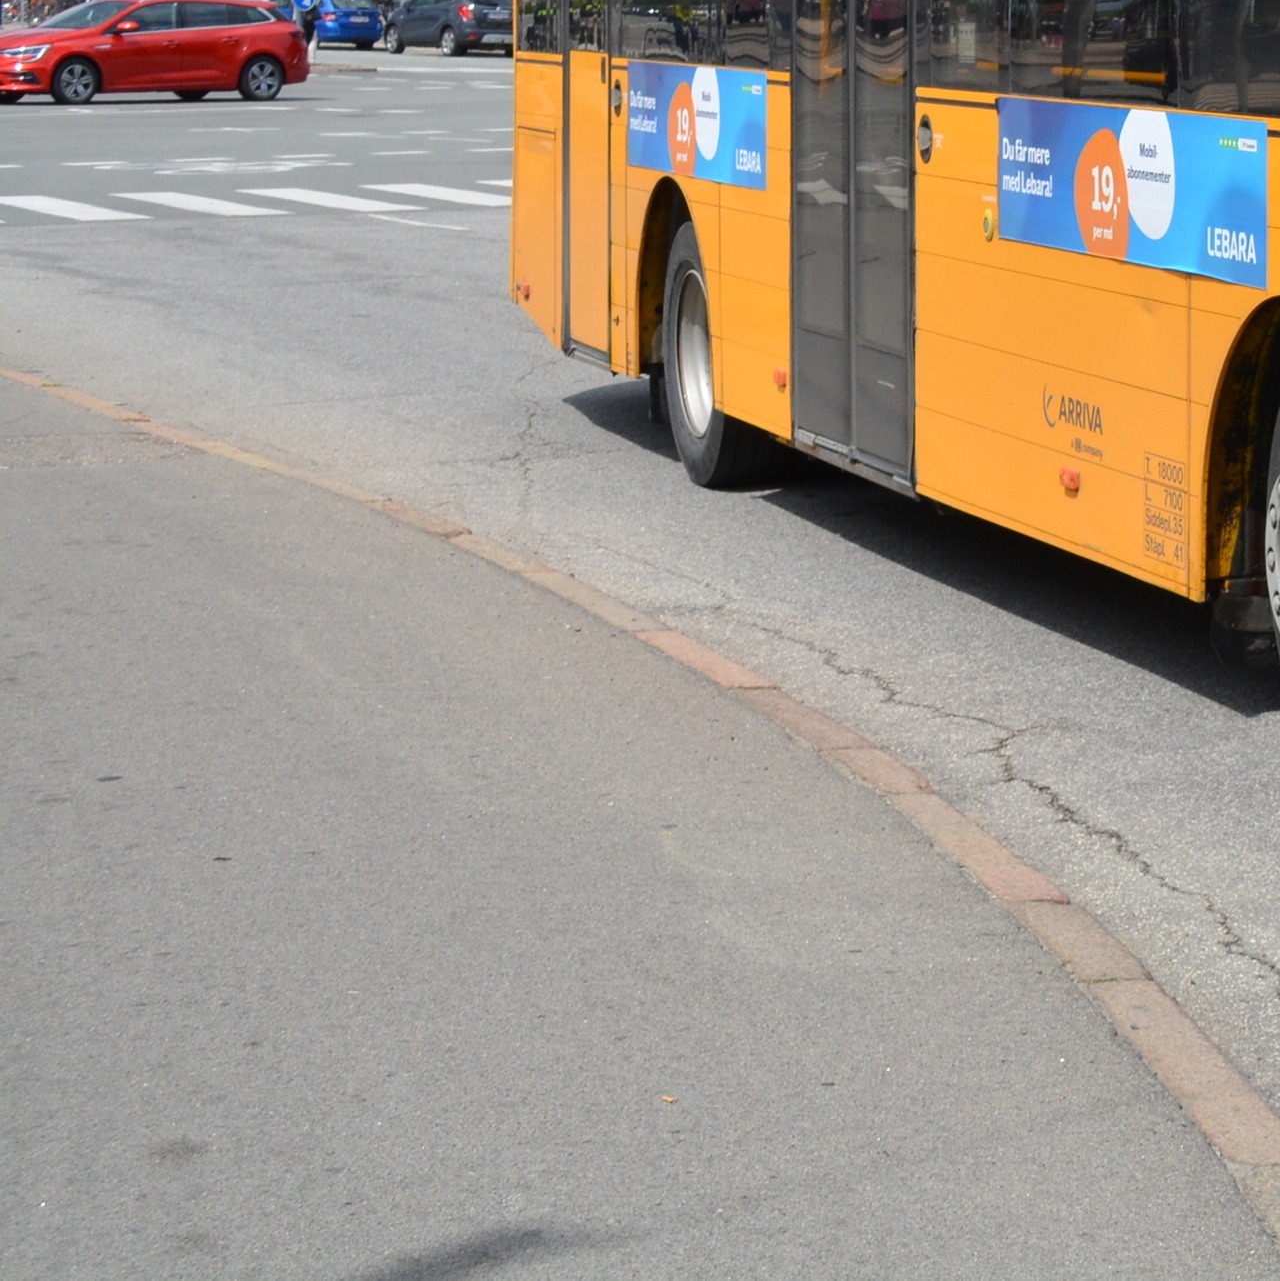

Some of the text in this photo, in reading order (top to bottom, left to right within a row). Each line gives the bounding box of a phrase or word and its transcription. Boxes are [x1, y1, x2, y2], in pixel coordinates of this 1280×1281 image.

[735, 148, 762, 174] LEBARA
[1002, 137, 1051, 166] Du får mere
[1139, 143, 1159, 159] Mobil-
[1003, 171, 1053, 198] med Lebara!
[1127, 168, 1171, 184] abonnementer
[1093, 226, 1113, 241] per md
[1207, 226, 1257, 264] LEBARA
[1058, 394, 1103, 436] ARRIVA
[1157, 461, 1183, 485] 18000
[1164, 489, 1183, 512] 7100
[1172, 517, 1183, 536] 35
[1173, 544, 1183, 562] 41
